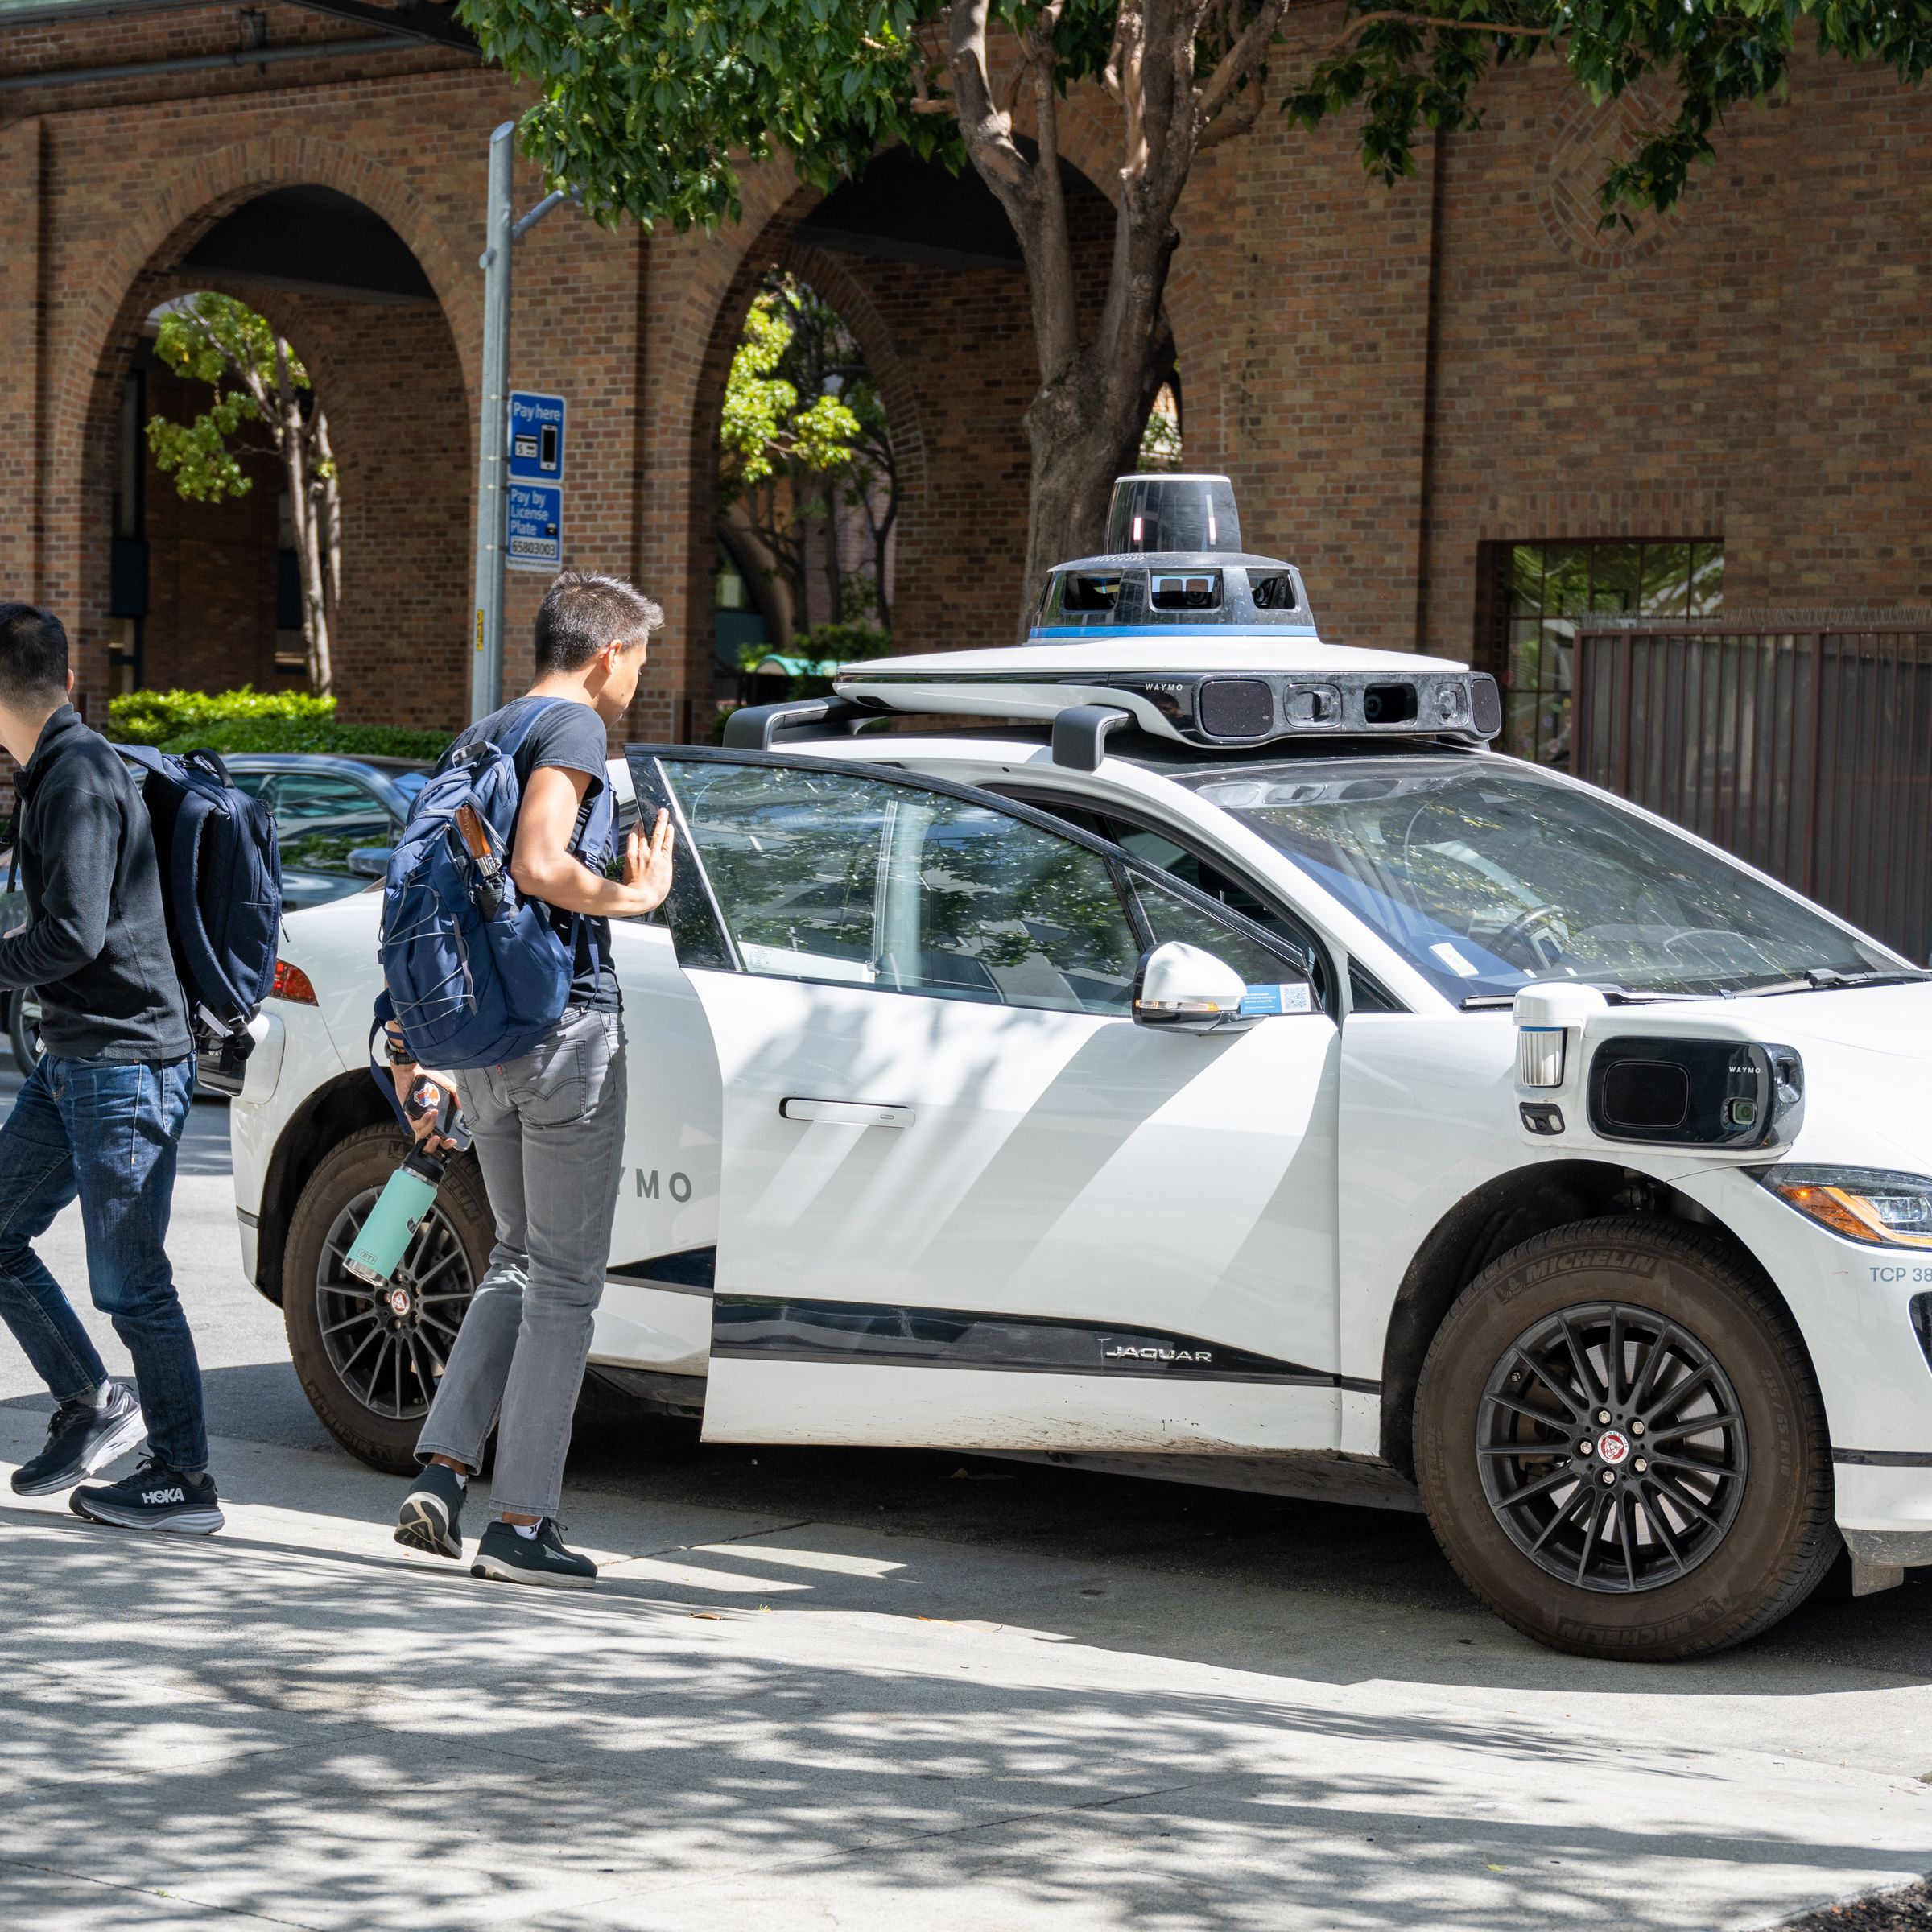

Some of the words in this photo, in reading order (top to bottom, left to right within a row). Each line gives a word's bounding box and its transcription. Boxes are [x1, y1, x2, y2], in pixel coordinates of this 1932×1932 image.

[514, 401, 535, 422] Pay
[535, 403, 561, 421] here
[510, 488, 530, 506] Pay
[532, 489, 546, 508] by
[510, 504, 549, 521] License
[510, 519, 537, 535] Plate
[1145, 683, 1183, 691] WAYMO
[1728, 1066, 1761, 1074] WAYMO
[360, 1249, 375, 1262] YETI
[1525, 1249, 1658, 1283] MICHELIN
[1869, 1267, 1906, 1282] TCP
[1105, 1346, 1212, 1362] JAGUAR
[141, 1488, 185, 1504] HOKA
